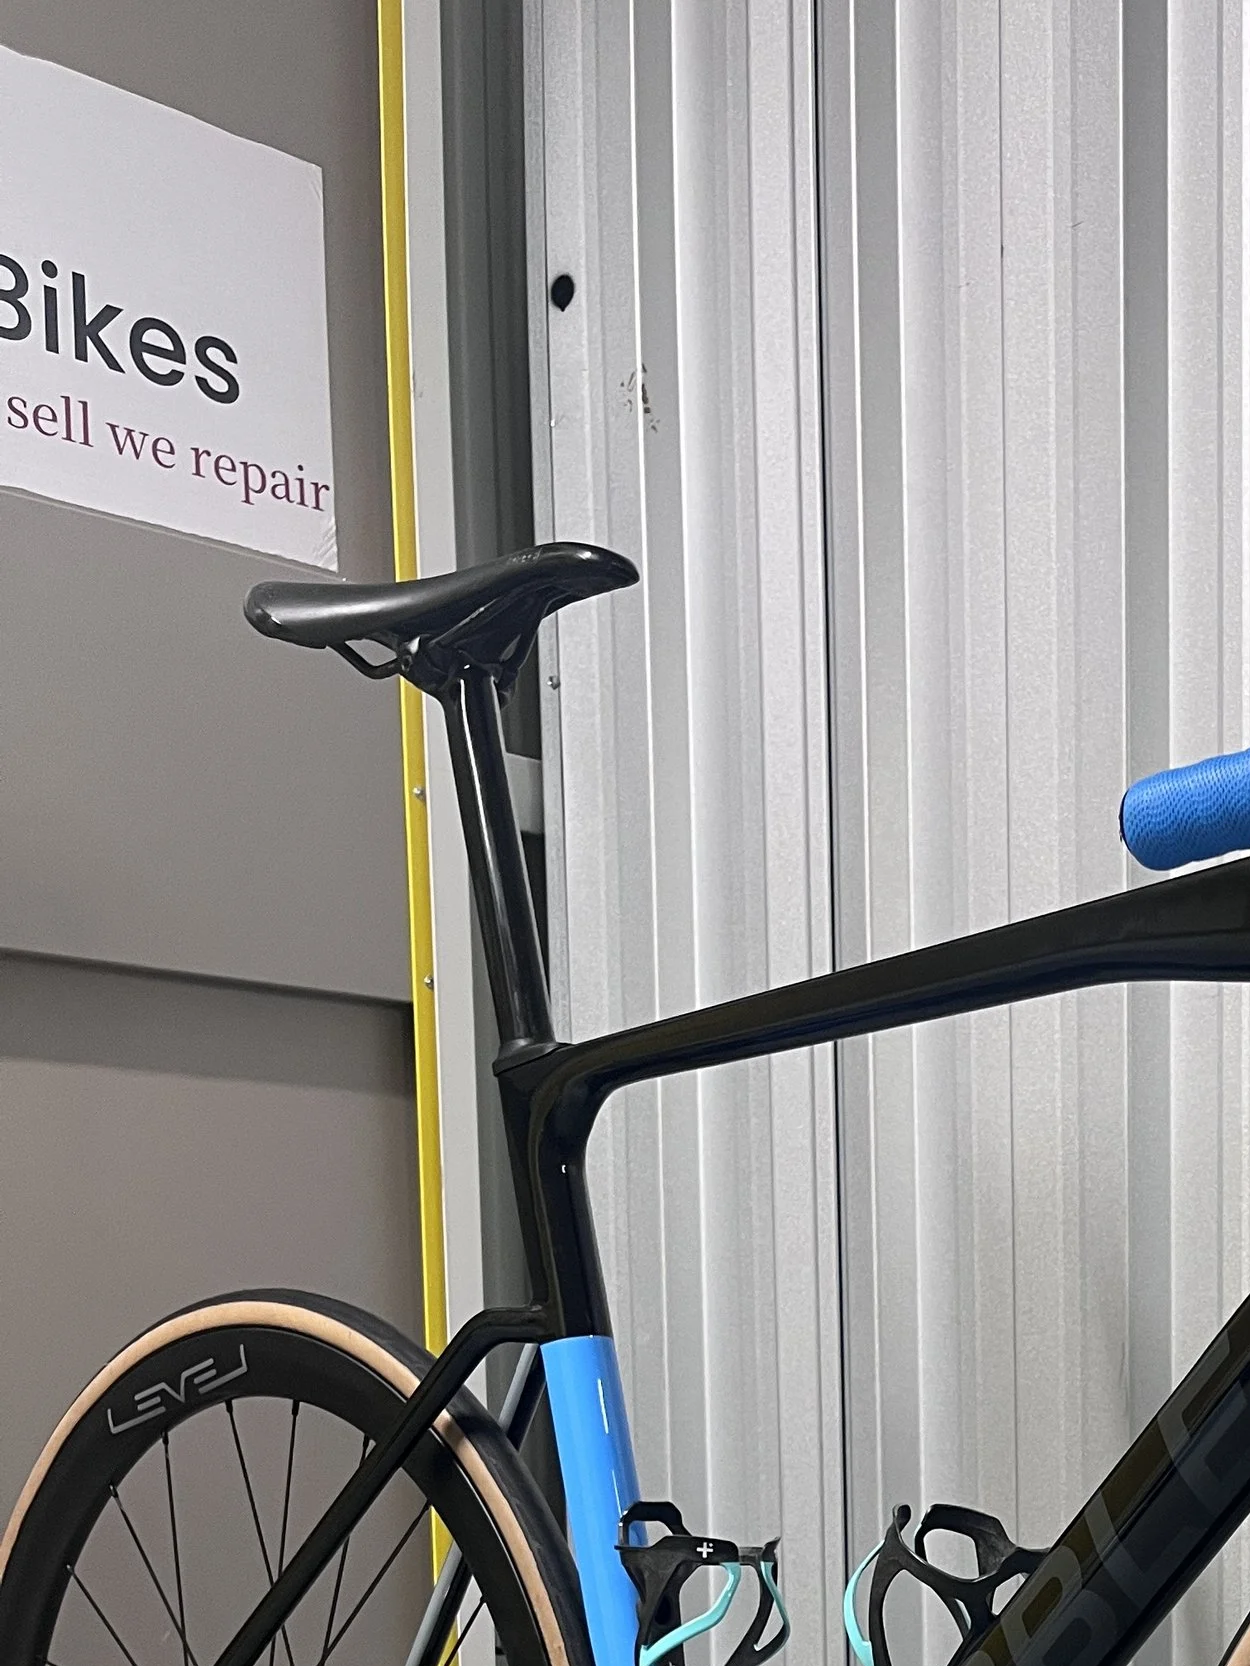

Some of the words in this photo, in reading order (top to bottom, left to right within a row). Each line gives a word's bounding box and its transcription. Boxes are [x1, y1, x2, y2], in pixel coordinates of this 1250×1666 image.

[0, 254, 241, 405] Bikes
[6, 395, 92, 448] sell
[105, 420, 177, 470] we
[190, 444, 331, 513] repair
[107, 1344, 248, 1434] LEVEL
